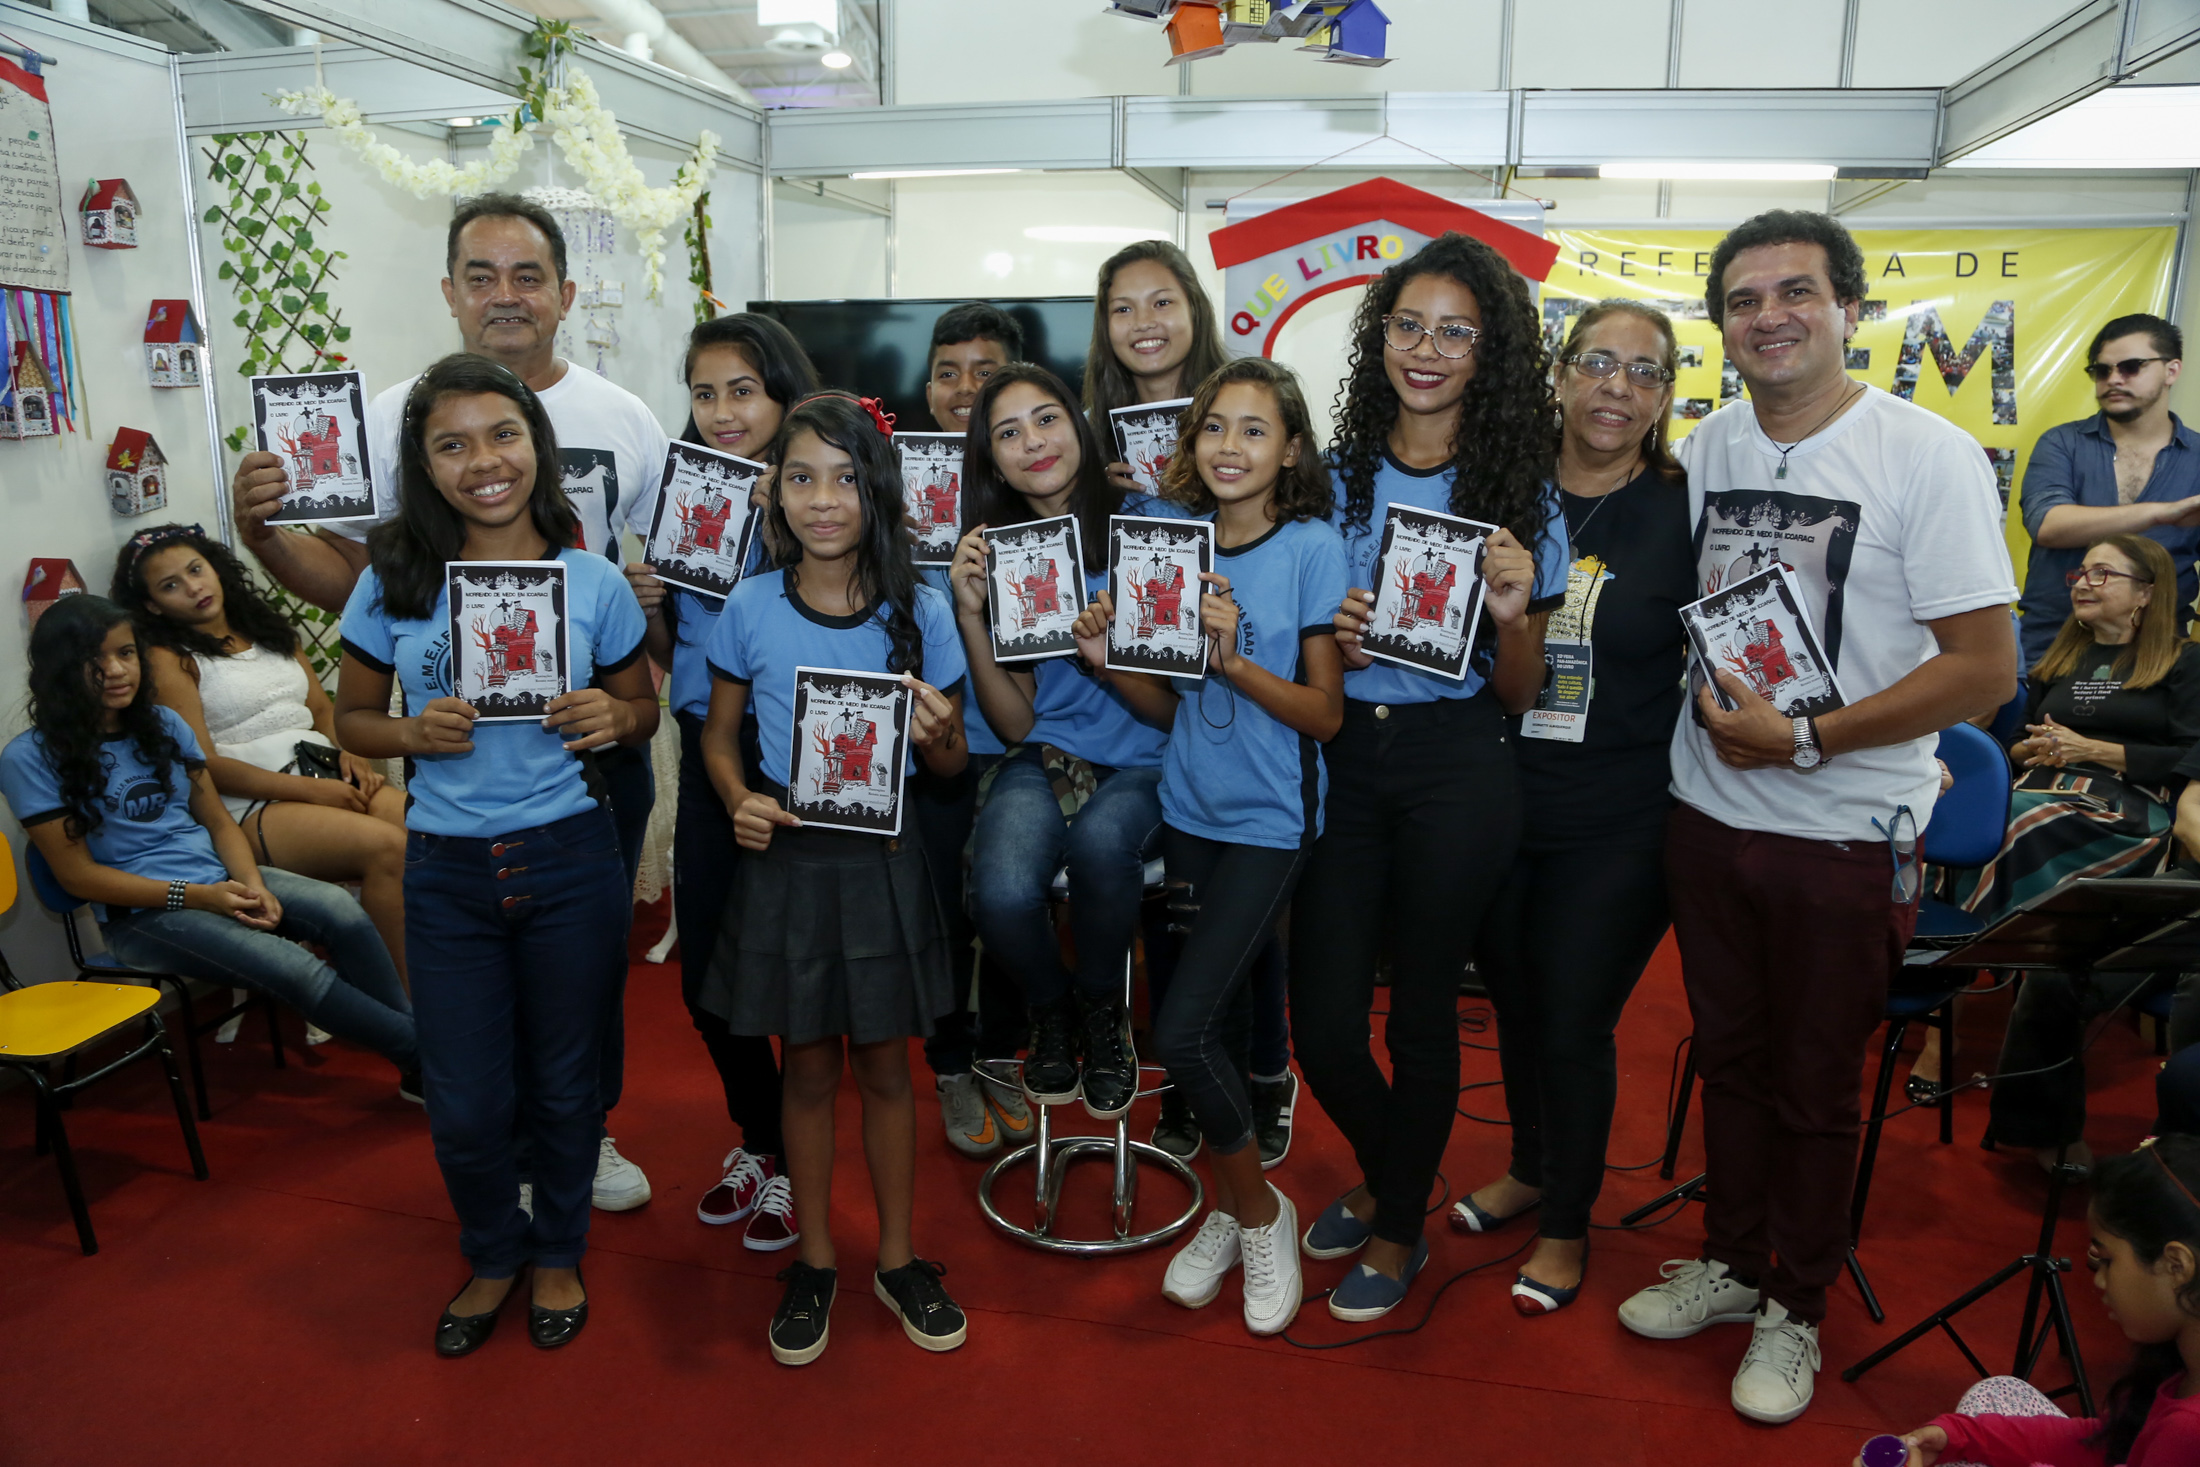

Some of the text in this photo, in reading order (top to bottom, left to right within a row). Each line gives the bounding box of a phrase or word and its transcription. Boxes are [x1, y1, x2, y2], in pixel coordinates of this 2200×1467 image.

[1956, 252, 2019, 278] DE
[1232, 236, 1404, 335] QUE LIVRO
[1712, 528, 1744, 536] MORRENDO
[1784, 533, 1815, 542] ICOARACI
[1242, 622, 1254, 656] RAAD
[1533, 711, 1576, 722] EXPOSITOR
[126, 793, 167, 818] MR
